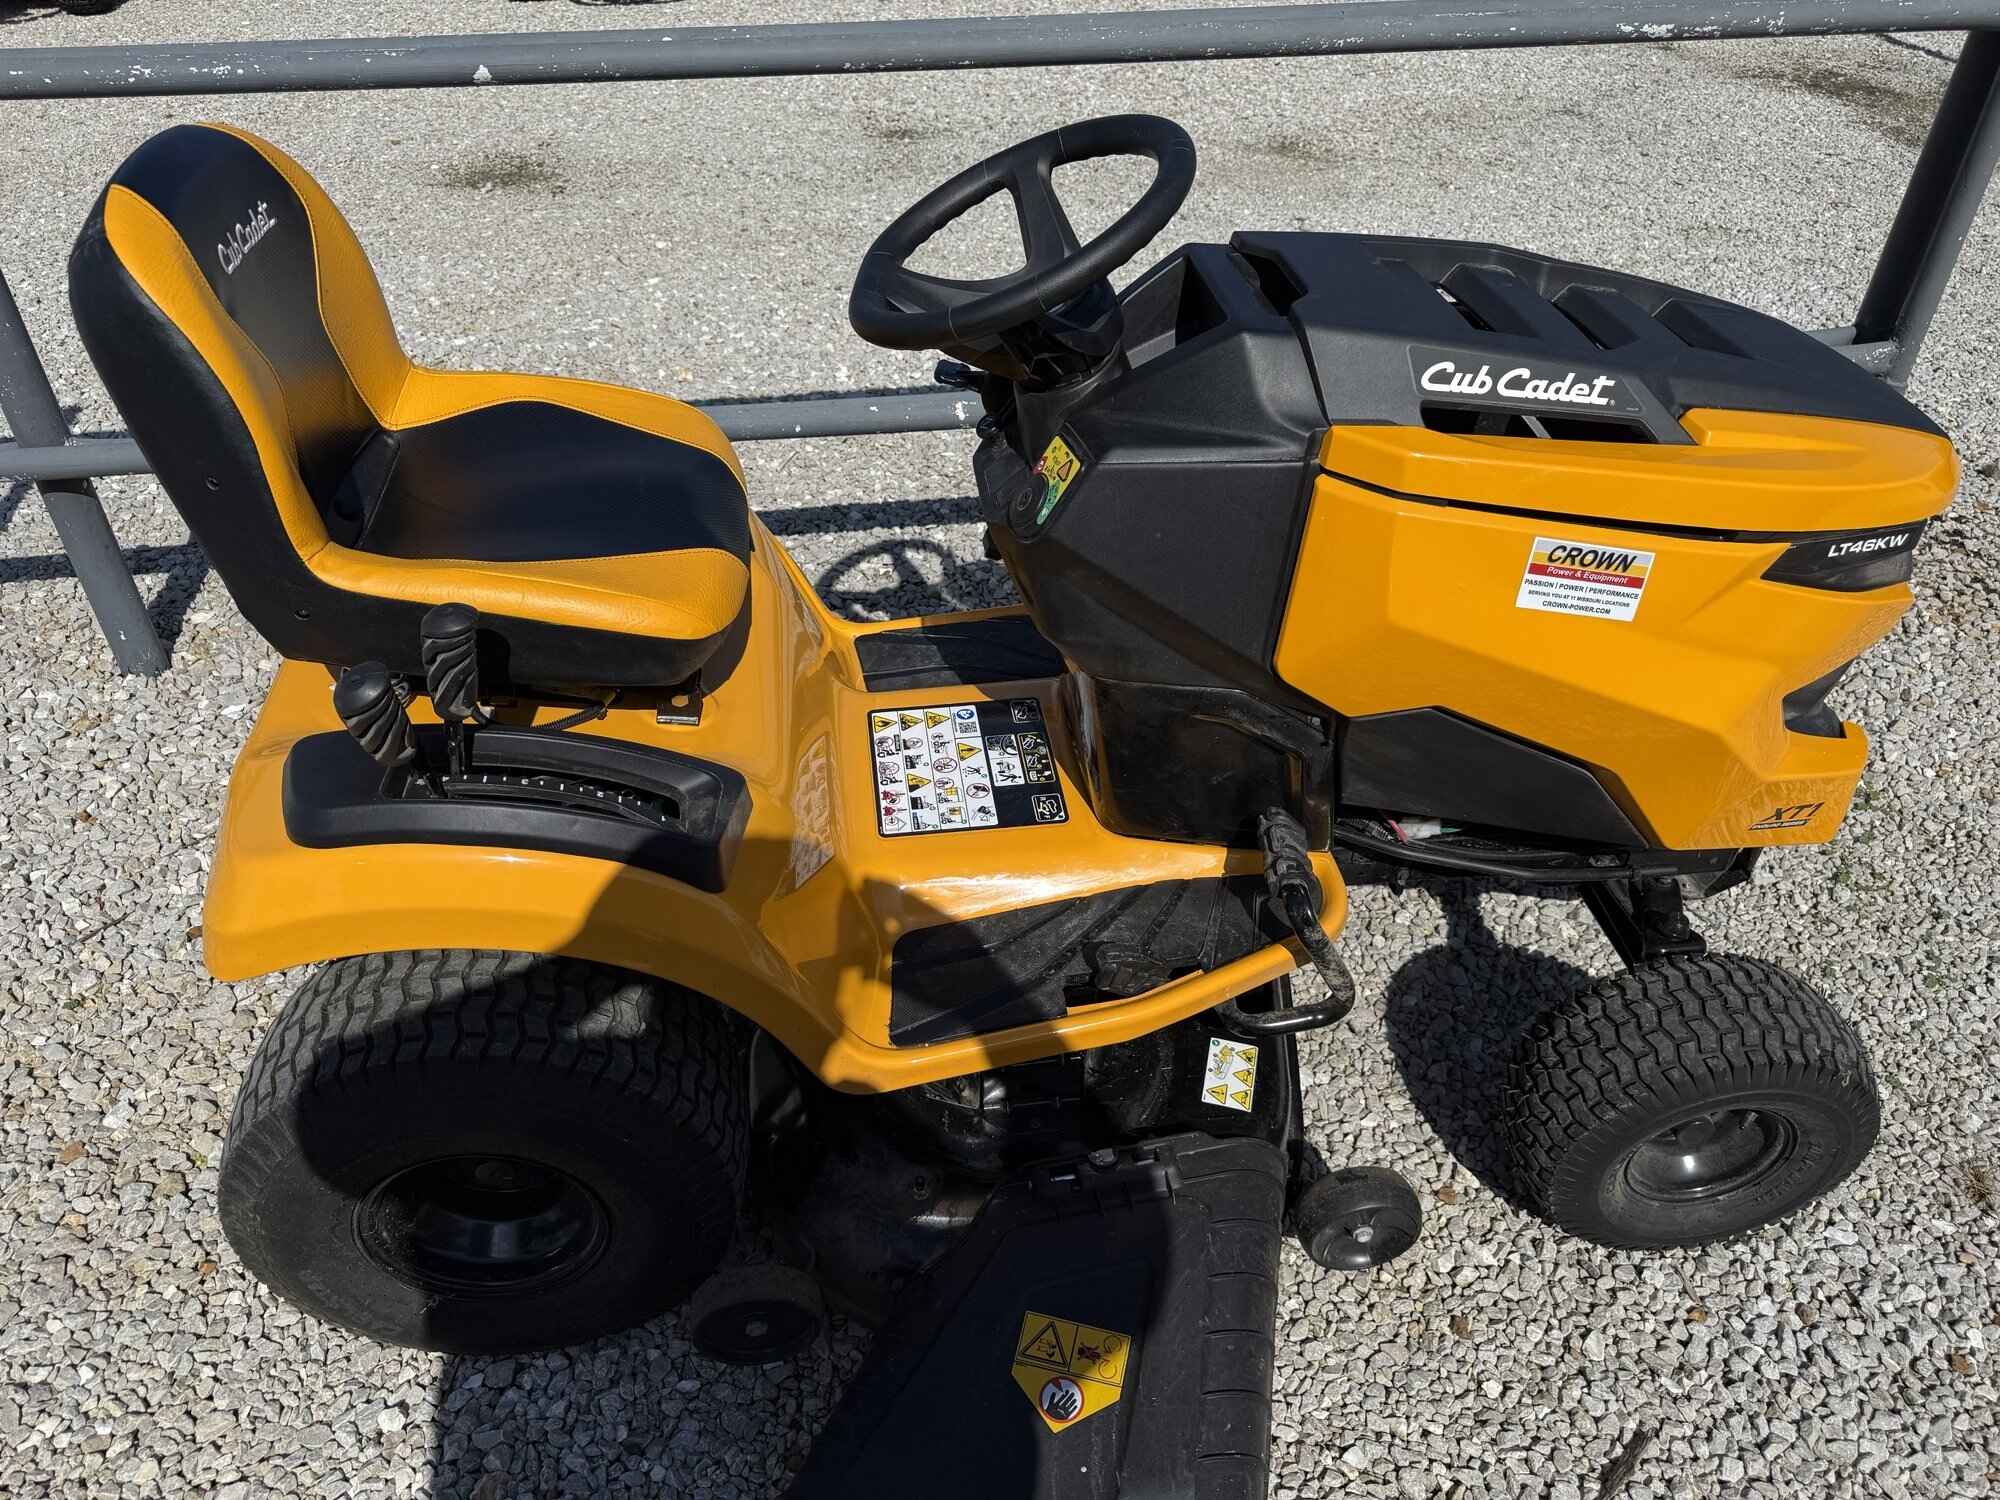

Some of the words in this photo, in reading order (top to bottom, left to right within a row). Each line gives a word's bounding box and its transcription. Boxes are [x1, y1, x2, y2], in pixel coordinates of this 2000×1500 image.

[217, 231, 243, 275] Cub
[235, 200, 276, 254] Cadet
[1421, 361, 1493, 395] Cub
[1497, 367, 1616, 405] Cadet
[1827, 533, 1909, 557] LT46KW
[1547, 545, 1637, 573] CROWN
[1547, 566, 1573, 576] Power
[1575, 570, 1581, 578] &
[1583, 571, 1628, 584] Equipment
[1524, 578, 1555, 588] PASSION
[1559, 583, 1584, 593] POWER
[1588, 587, 1639, 600] PERFORMANCE
[1528, 589, 1551, 597] SERVING
[1577, 596, 1601, 604] MISSOURI
[1602, 599, 1630, 608] LOCATIONS
[1542, 600, 1611, 615] CROWN-POWER.COM
